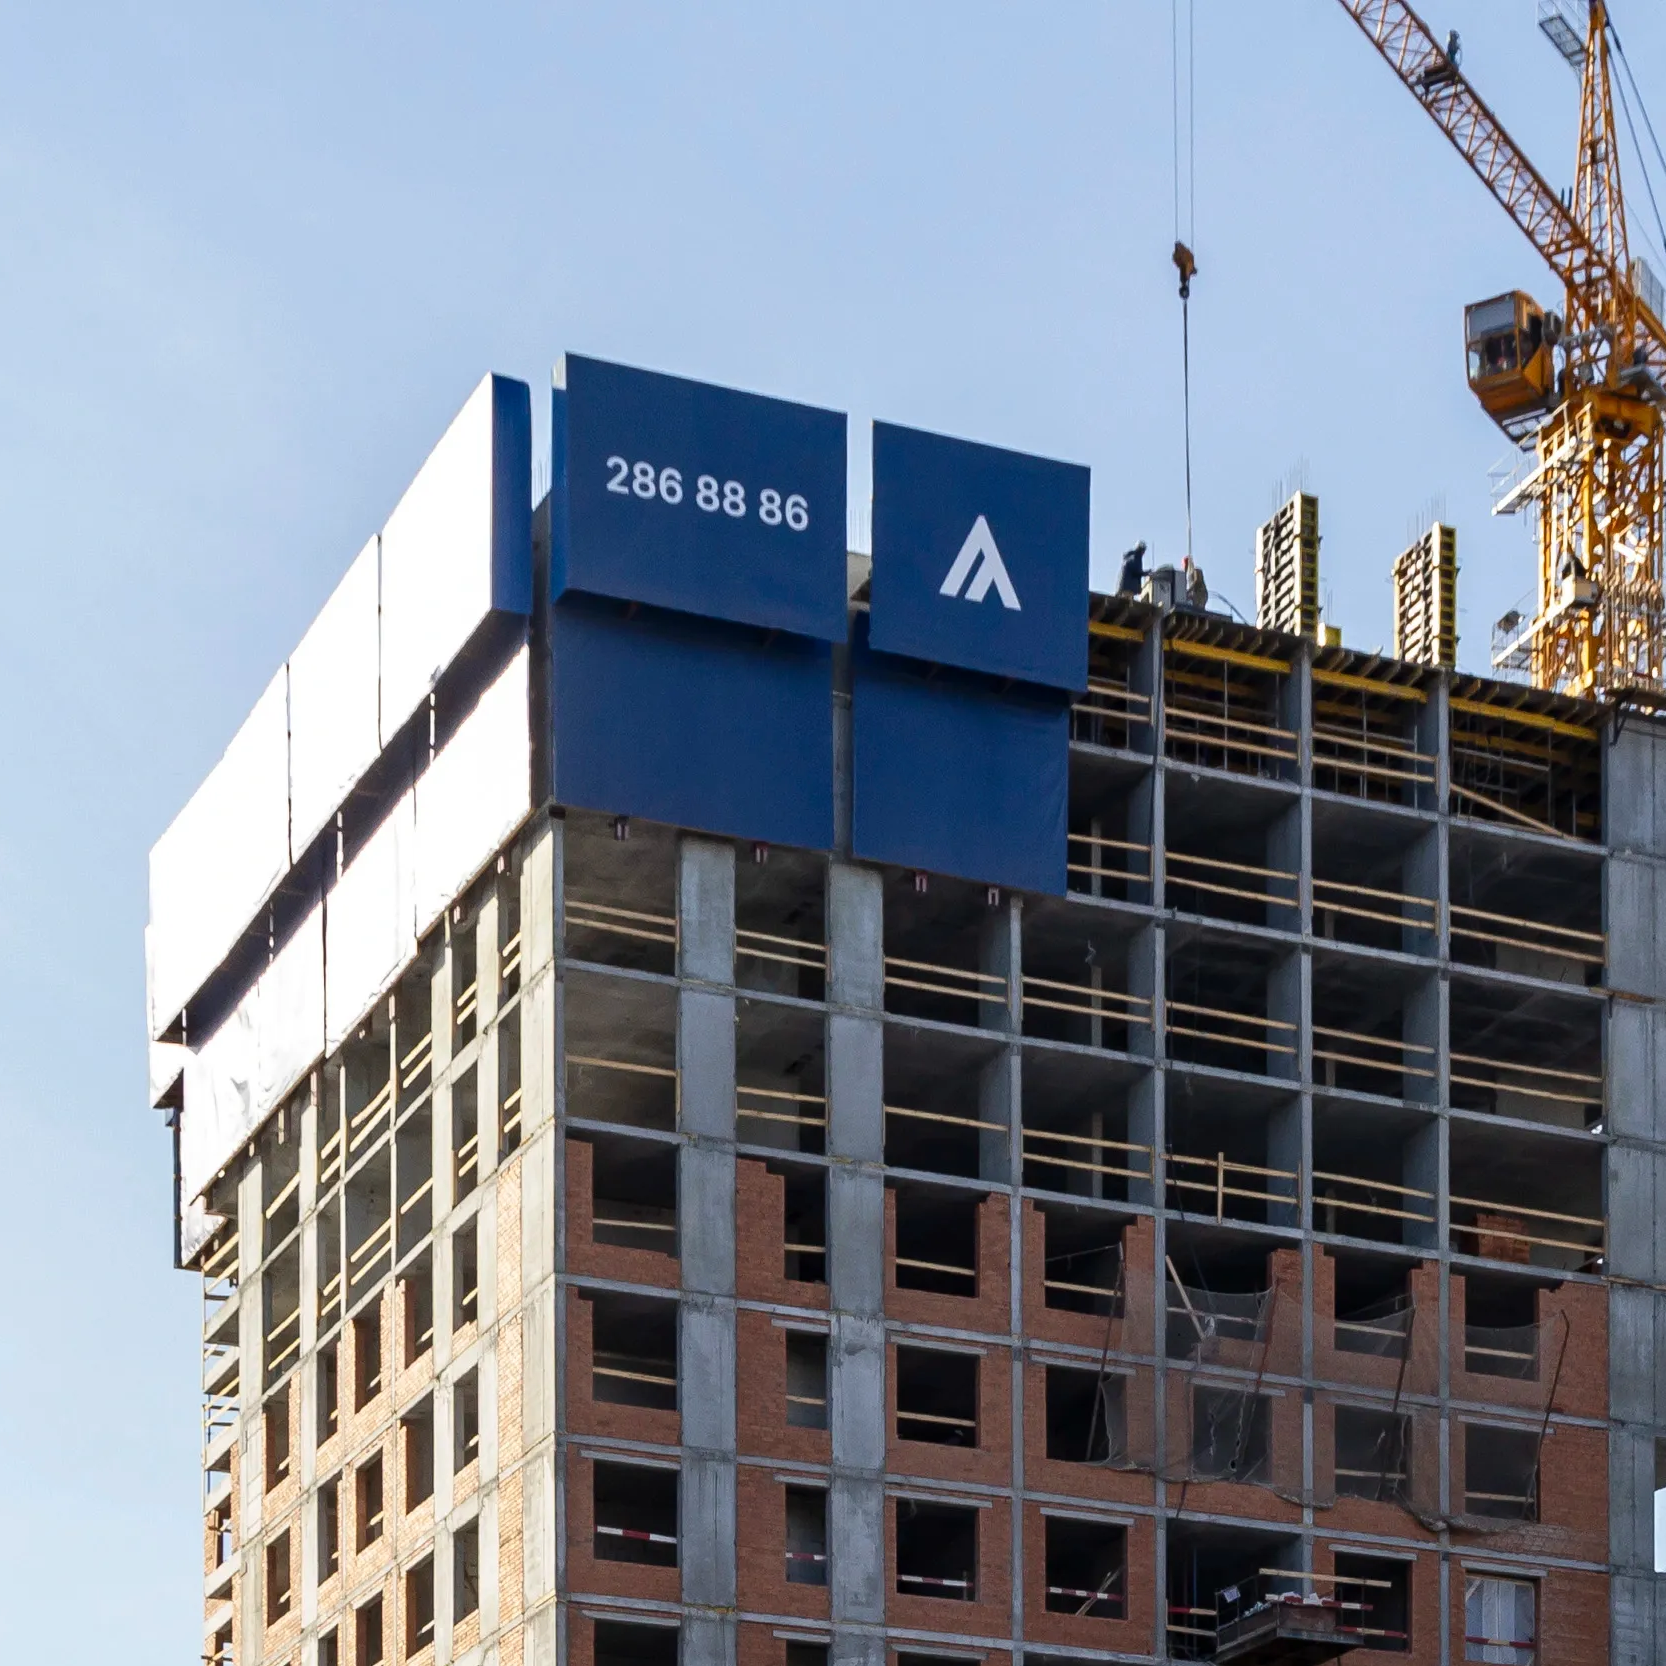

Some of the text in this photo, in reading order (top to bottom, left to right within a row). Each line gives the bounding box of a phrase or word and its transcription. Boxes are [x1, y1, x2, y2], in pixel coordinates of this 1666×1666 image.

[606, 456, 809, 531] 286 88 86
